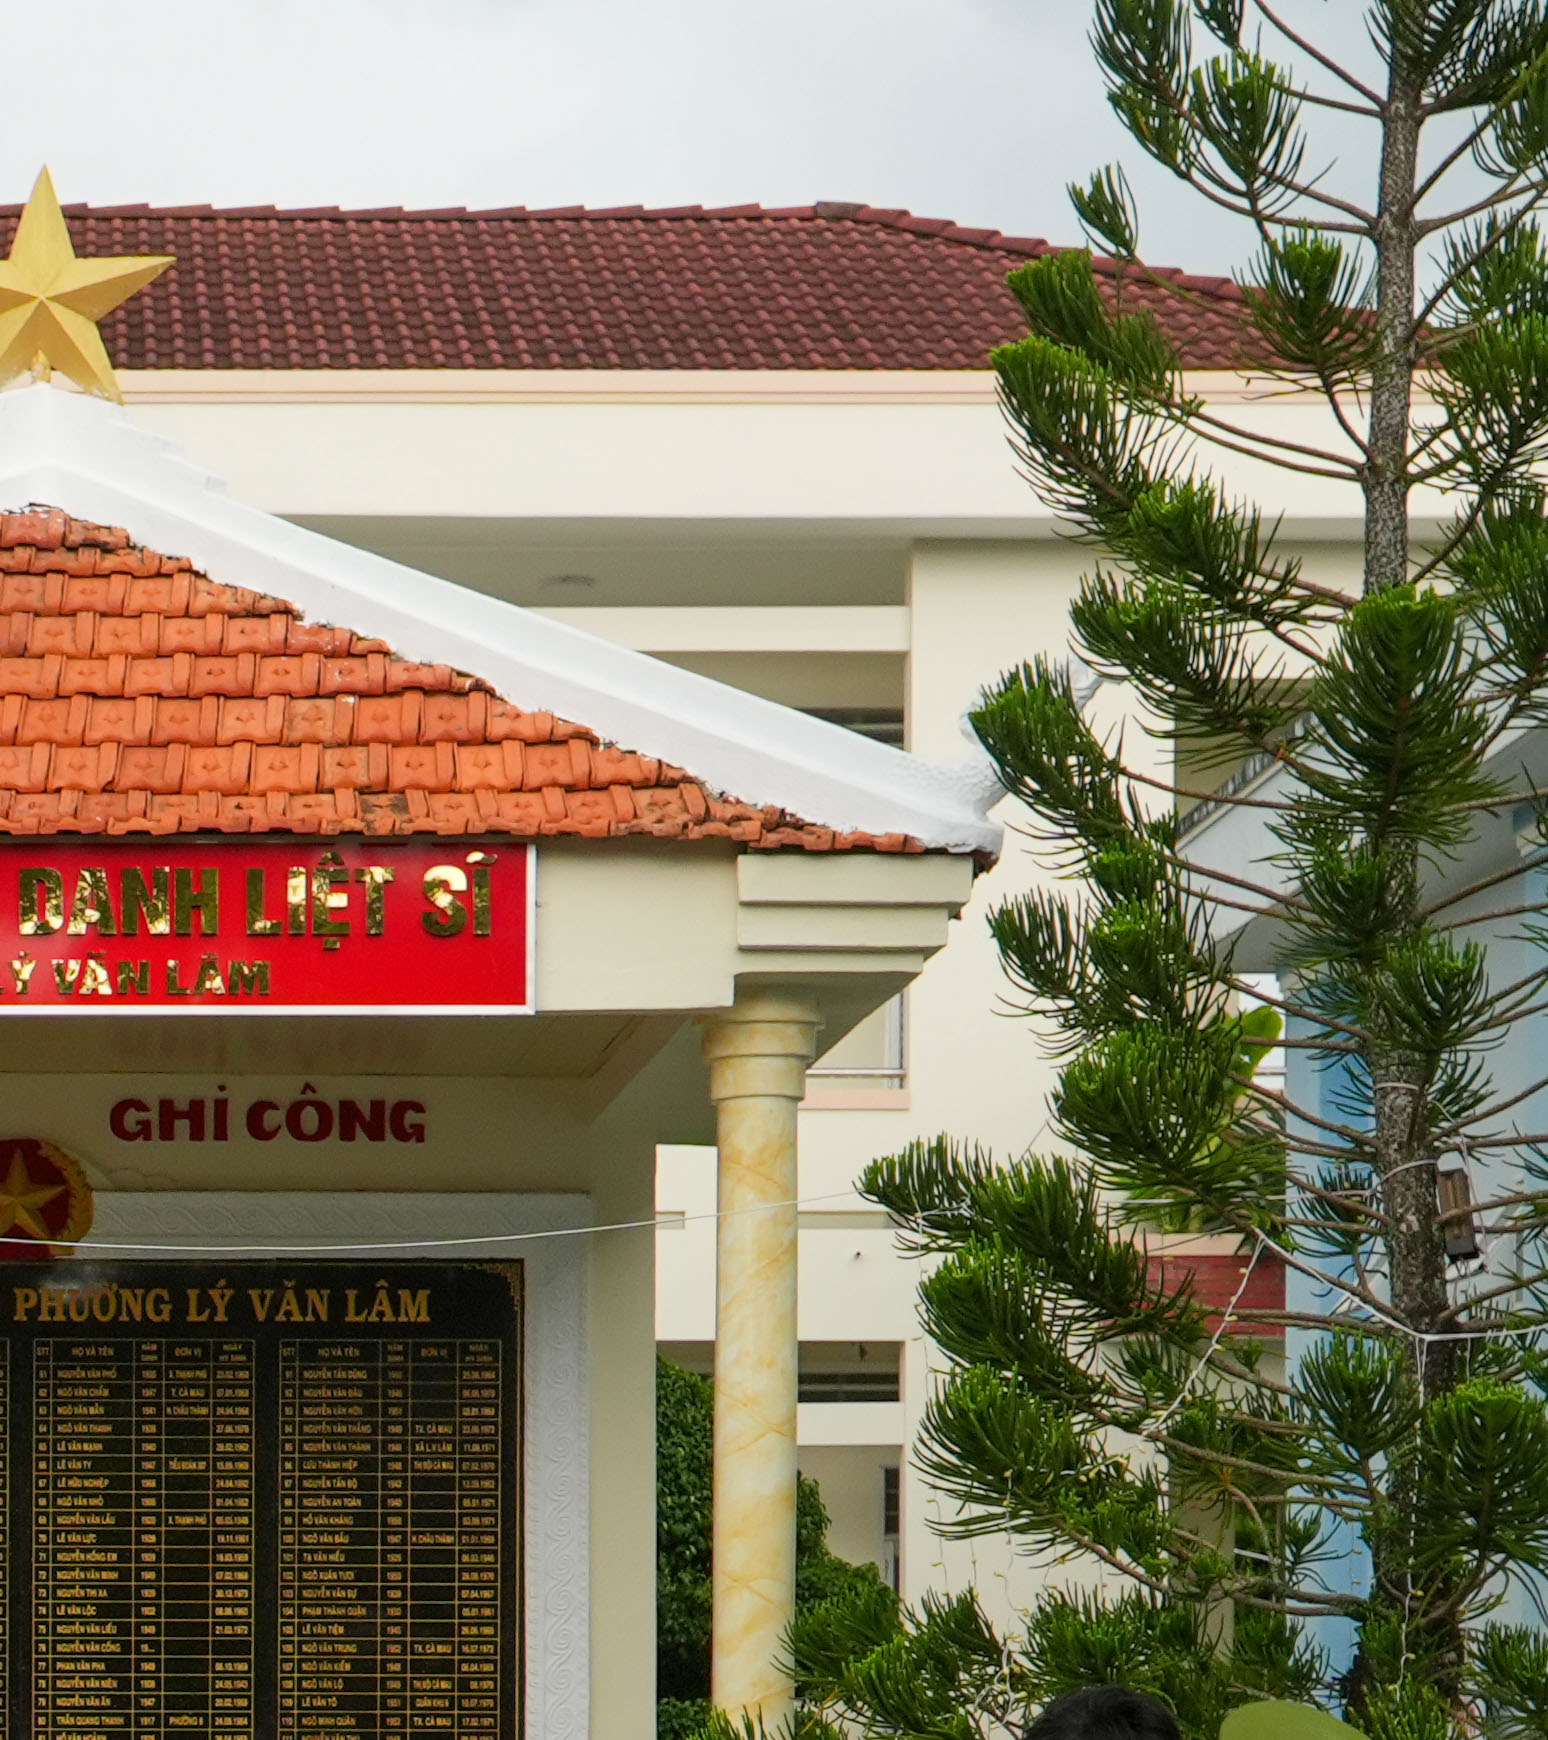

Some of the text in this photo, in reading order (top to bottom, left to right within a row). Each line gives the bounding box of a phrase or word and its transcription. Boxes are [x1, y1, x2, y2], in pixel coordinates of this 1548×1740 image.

[17, 866, 219, 935] DANH
[246, 851, 394, 950] LIỆT
[420, 851, 495, 938] SĨ
[51, 953, 150, 995] VĂN
[165, 950, 270, 996] LÂM
[109, 1085, 228, 1142] GHI
[245, 1082, 427, 1144] CÔNG
[13, 1282, 172, 1323] PHƯỜNG
[186, 1278, 233, 1323] LÝ
[248, 1281, 330, 1323] VĂN
[344, 1279, 431, 1323] LÂM
